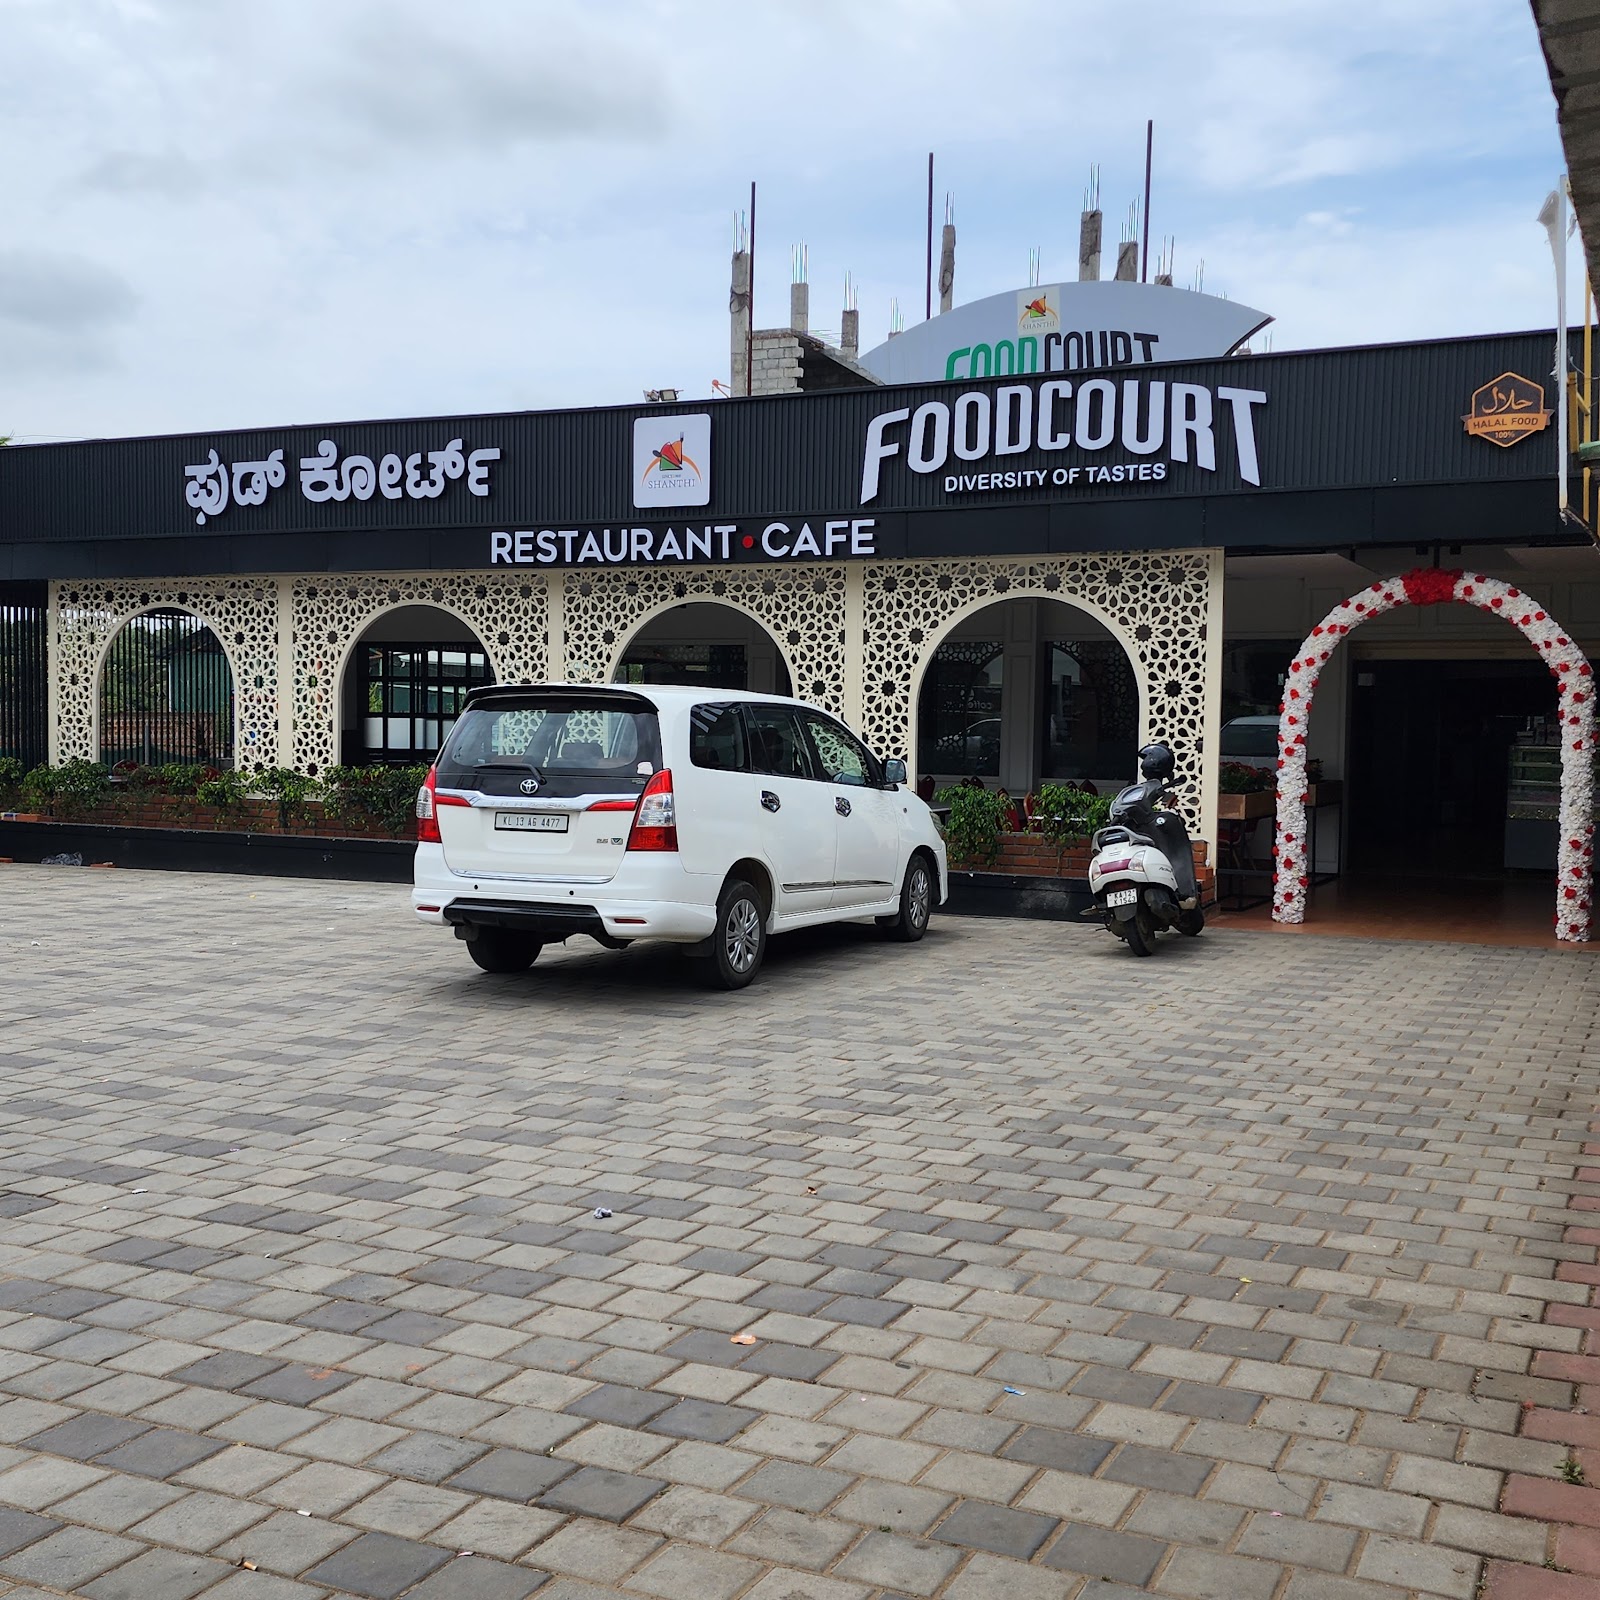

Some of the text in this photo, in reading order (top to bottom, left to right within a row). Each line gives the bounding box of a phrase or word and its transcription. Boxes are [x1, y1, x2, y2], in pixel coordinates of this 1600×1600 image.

[1023, 321, 1055, 330] SHANTHI
[1482, 386, 1533, 413] حلال
[1473, 417, 1539, 429] HALAL FOOD
[861, 379, 1267, 505] FOODCOURT
[648, 479, 695, 489] SHANTHI
[945, 462, 1166, 493] DIVERSITY OF TASTES
[491, 519, 875, 563] RESTAURANT CAFE
[503, 816, 512, 826] KL
[516, 817, 525, 826] 13
[541, 818, 560, 828] 4477
